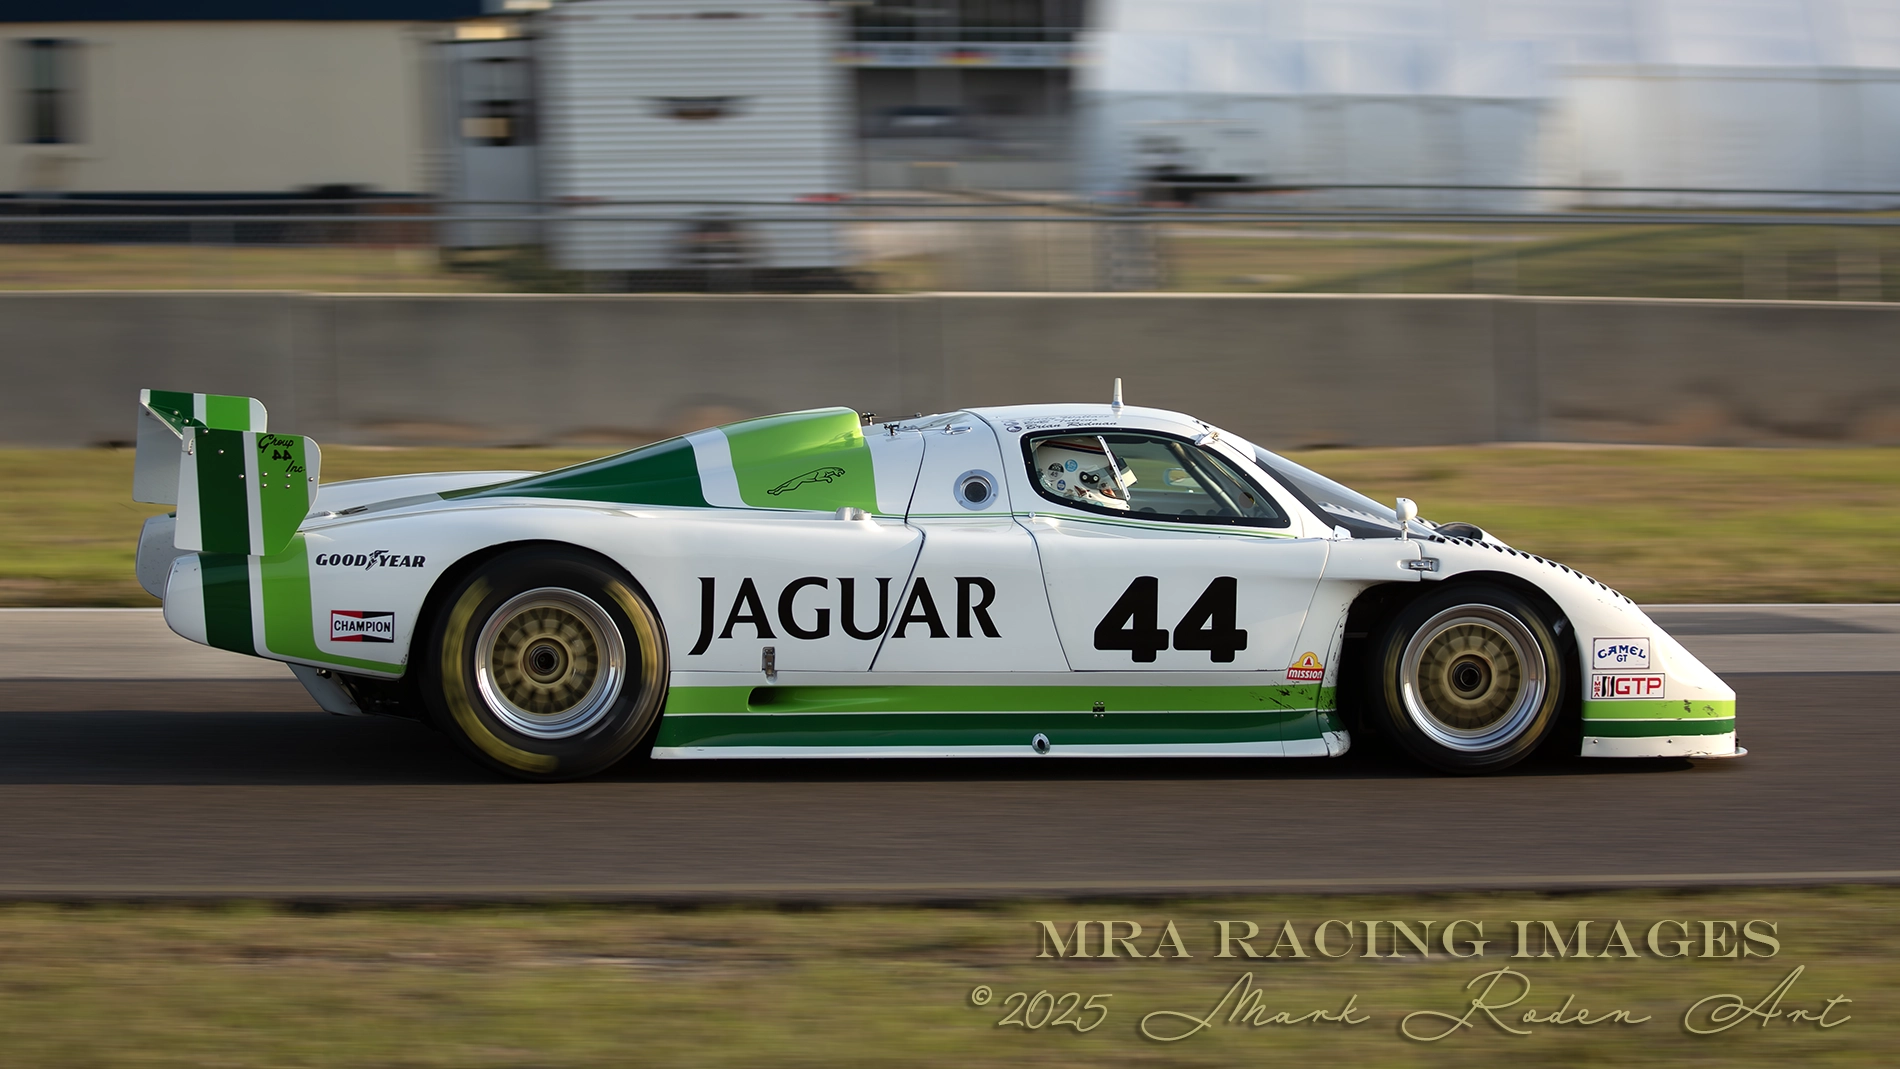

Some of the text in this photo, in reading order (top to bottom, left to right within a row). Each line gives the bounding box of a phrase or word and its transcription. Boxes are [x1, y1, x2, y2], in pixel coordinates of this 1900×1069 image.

[258, 434, 294, 453] Group
[688, 576, 1002, 655] JAGUAR
[1093, 576, 1248, 663] 44
[333, 620, 391, 633] CHAMPION
[1597, 645, 1646, 659] CAMEL
[1616, 654, 1628, 662] GT
[1615, 677, 1662, 695] GTP
